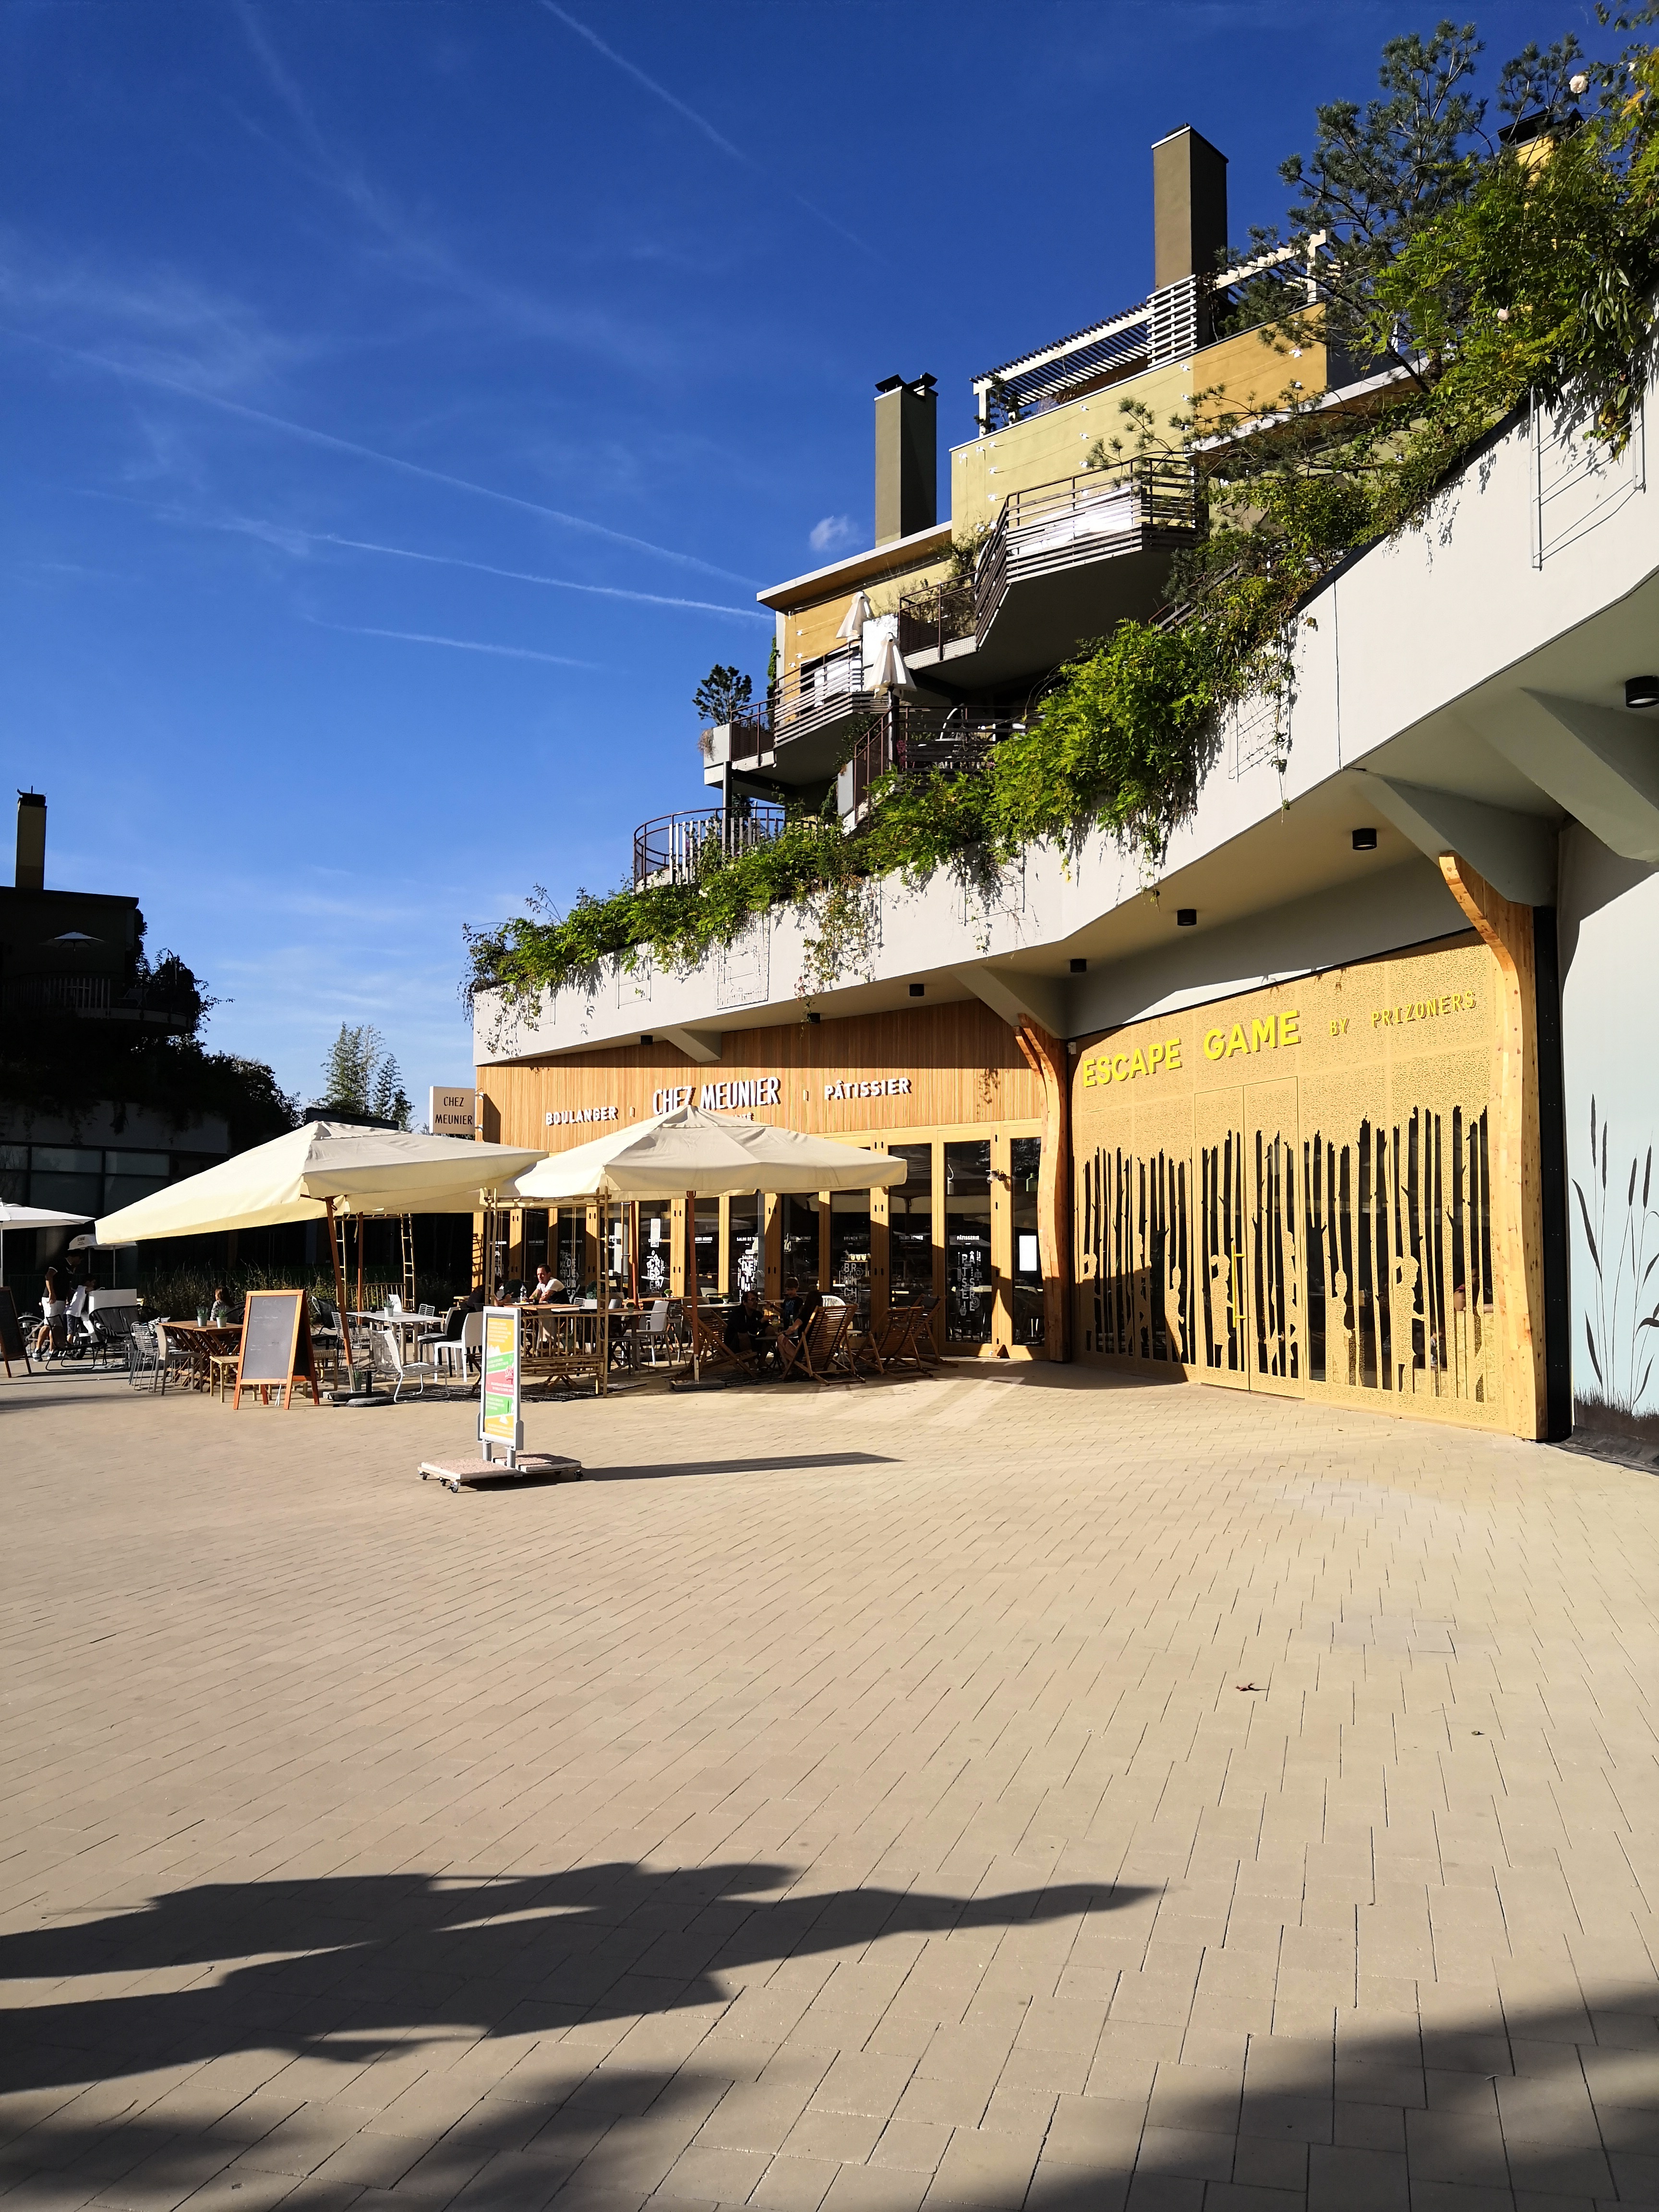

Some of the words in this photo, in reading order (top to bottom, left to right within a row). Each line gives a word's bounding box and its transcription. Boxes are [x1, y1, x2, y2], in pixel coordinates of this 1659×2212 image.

[1082, 1037, 1182, 1087] ESCAPE
[1203, 1010, 1301, 1060] GAME
[1329, 1018, 1349, 1036] BY
[1371, 990, 1477, 1028] PRIZONERS
[653, 1085, 696, 1116] CHEZ
[700, 1076, 781, 1111] MEUNIER
[824, 1077, 912, 1101] PÂTISSIER
[444, 1096, 464, 1107] CHEZ
[435, 1114, 472, 1125] MEUNIER
[545, 1106, 619, 1126] BOULANGER
